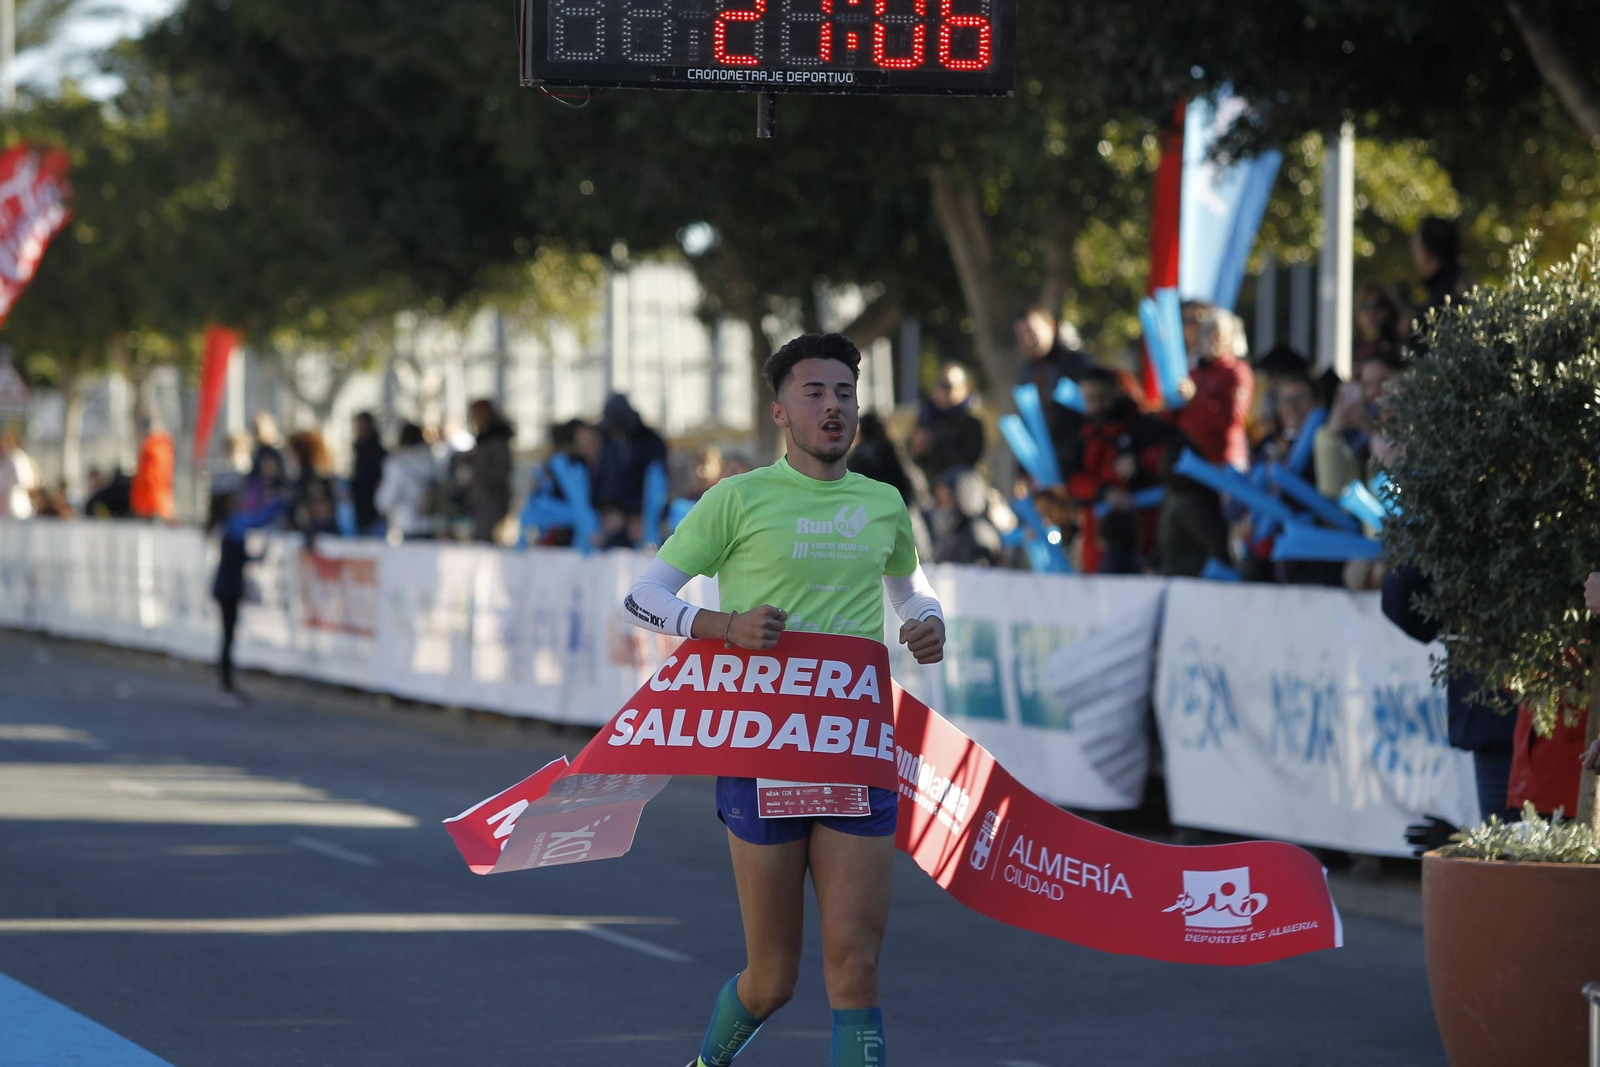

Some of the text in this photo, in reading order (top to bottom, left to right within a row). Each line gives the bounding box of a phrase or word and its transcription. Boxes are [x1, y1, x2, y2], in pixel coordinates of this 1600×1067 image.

[687, 69, 854, 84] CRONOMETRAJE DEPORTIVO
[796, 517, 833, 534] Run
[837, 543, 857, 551] RUN
[649, 653, 882, 704] CARRERA
[607, 708, 895, 762] SALUDABLE
[1003, 864, 1064, 902] CIUDAD
[1008, 834, 1133, 899] ALMERÍA
[1184, 933, 1247, 944] DEPORTES
[1250, 930, 1266, 942] DE
[856, 1029, 884, 1067] nji
